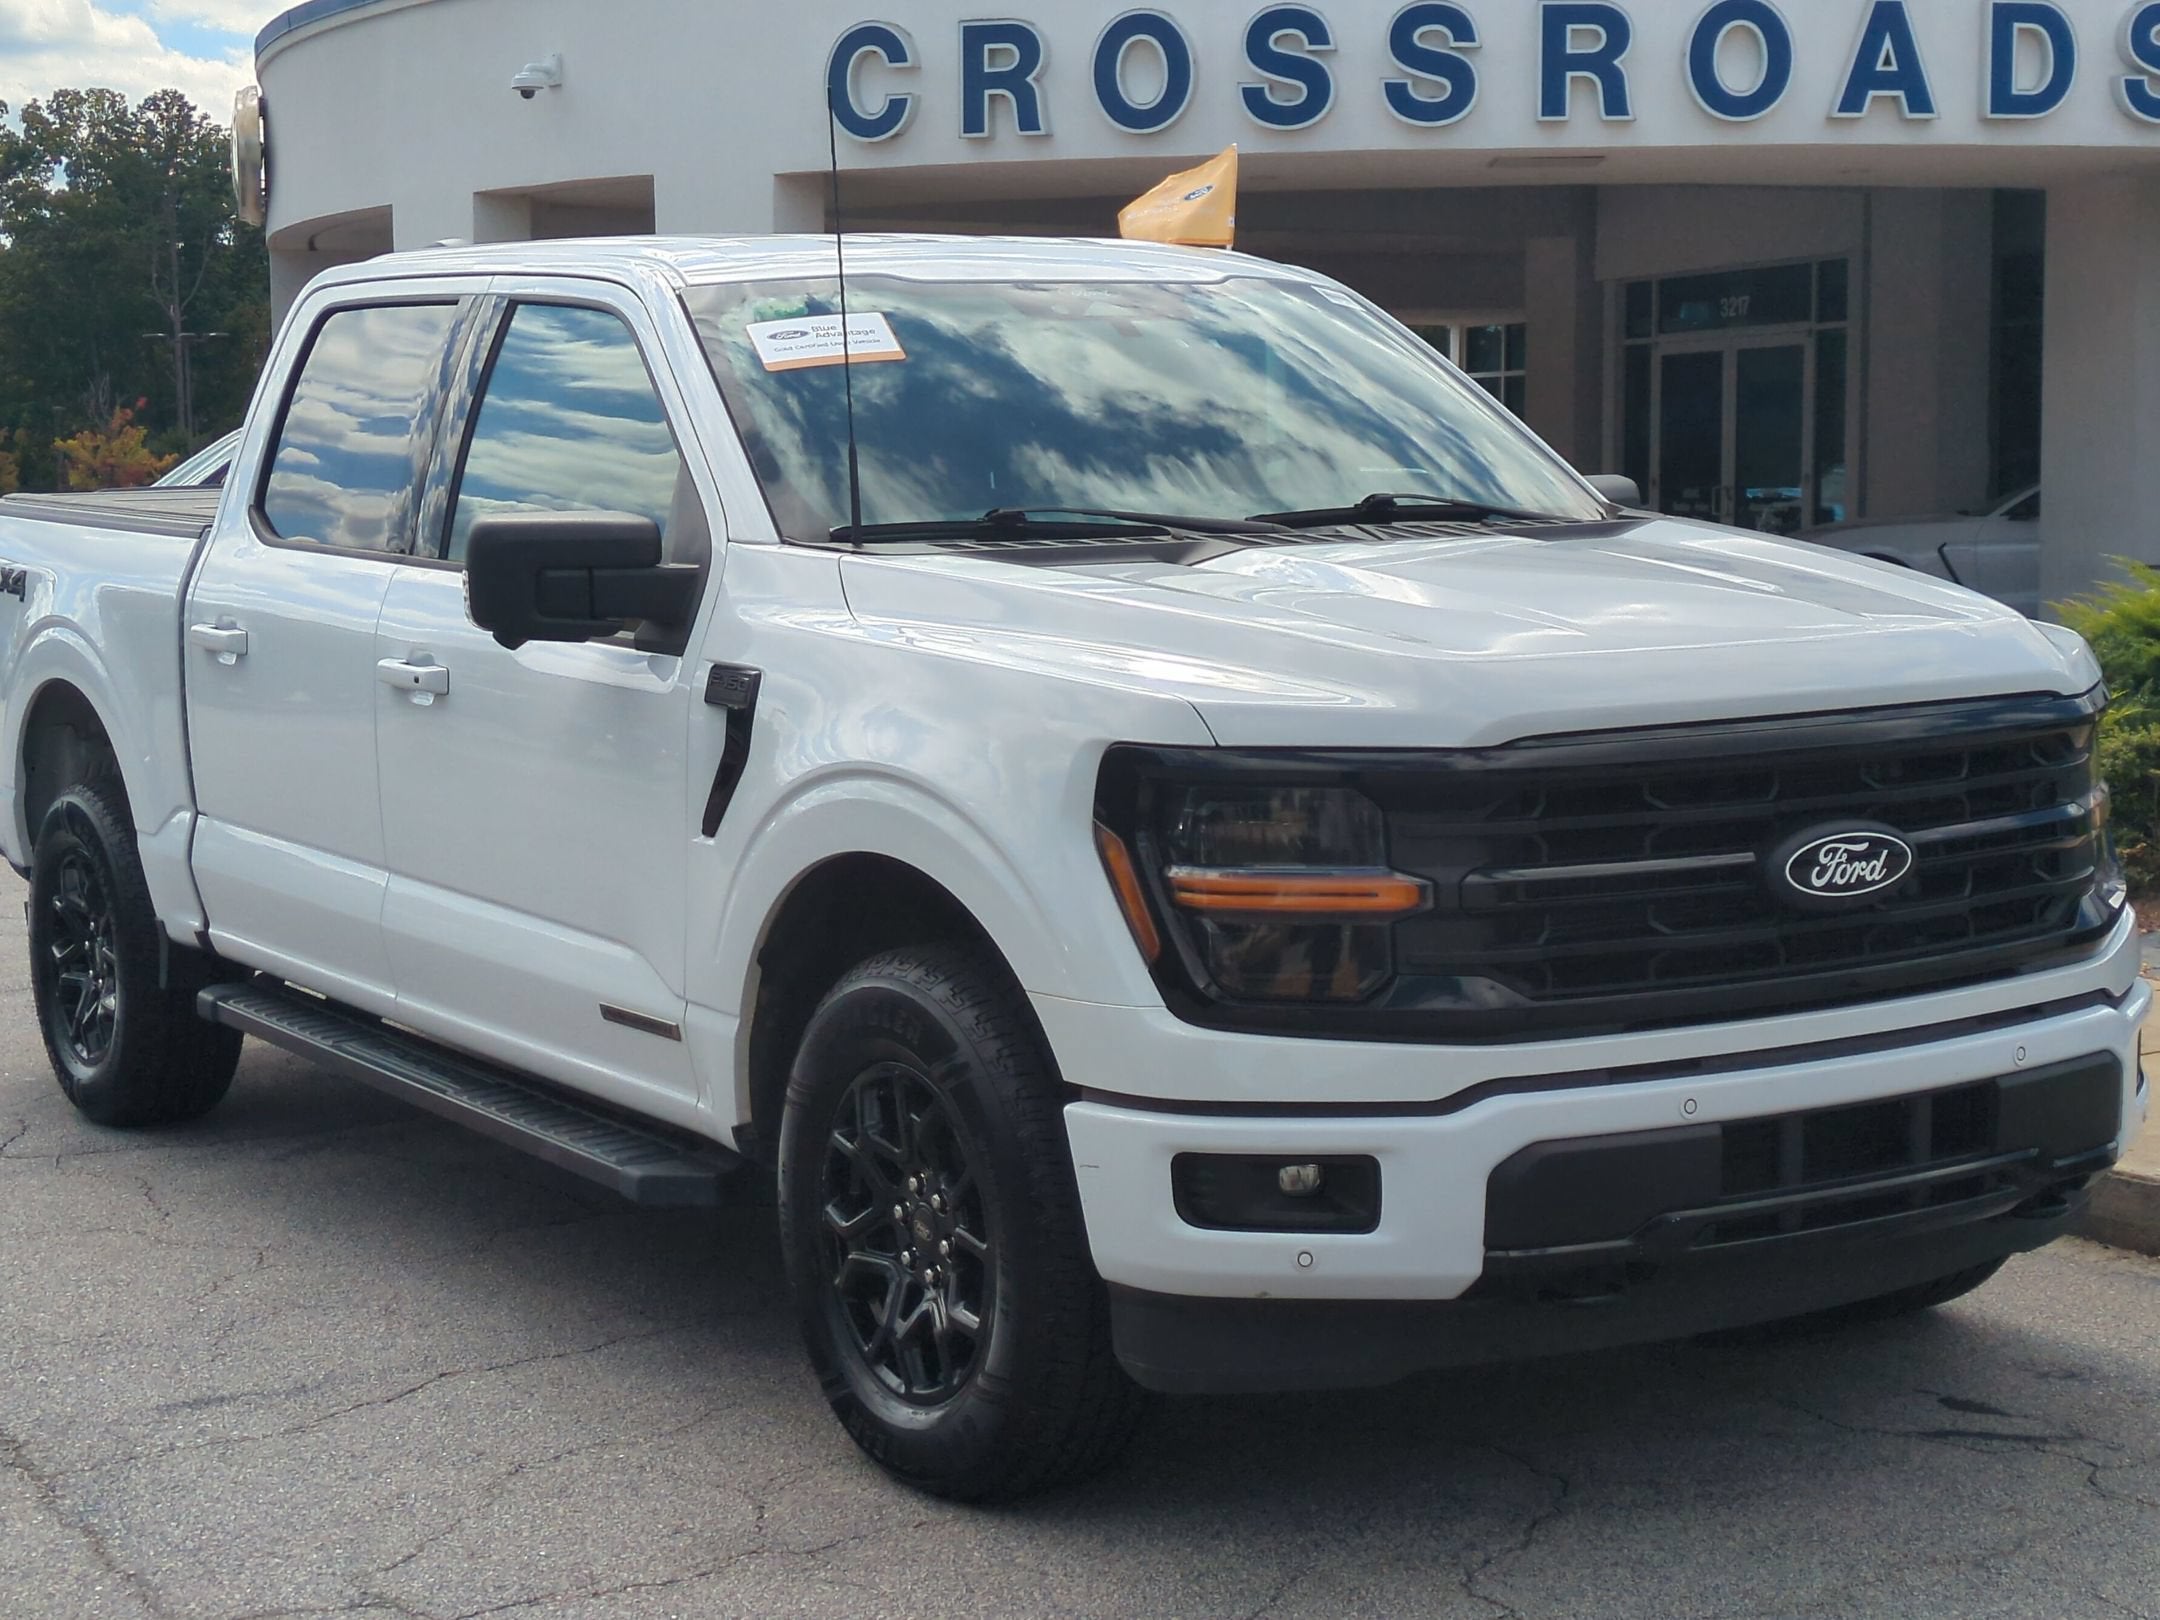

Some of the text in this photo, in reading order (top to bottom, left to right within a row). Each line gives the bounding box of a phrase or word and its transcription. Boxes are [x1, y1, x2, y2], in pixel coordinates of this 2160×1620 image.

[1720, 296, 1750, 318] 3217
[811, 325, 837, 333] Blue
[1811, 841, 1889, 887] Ford
